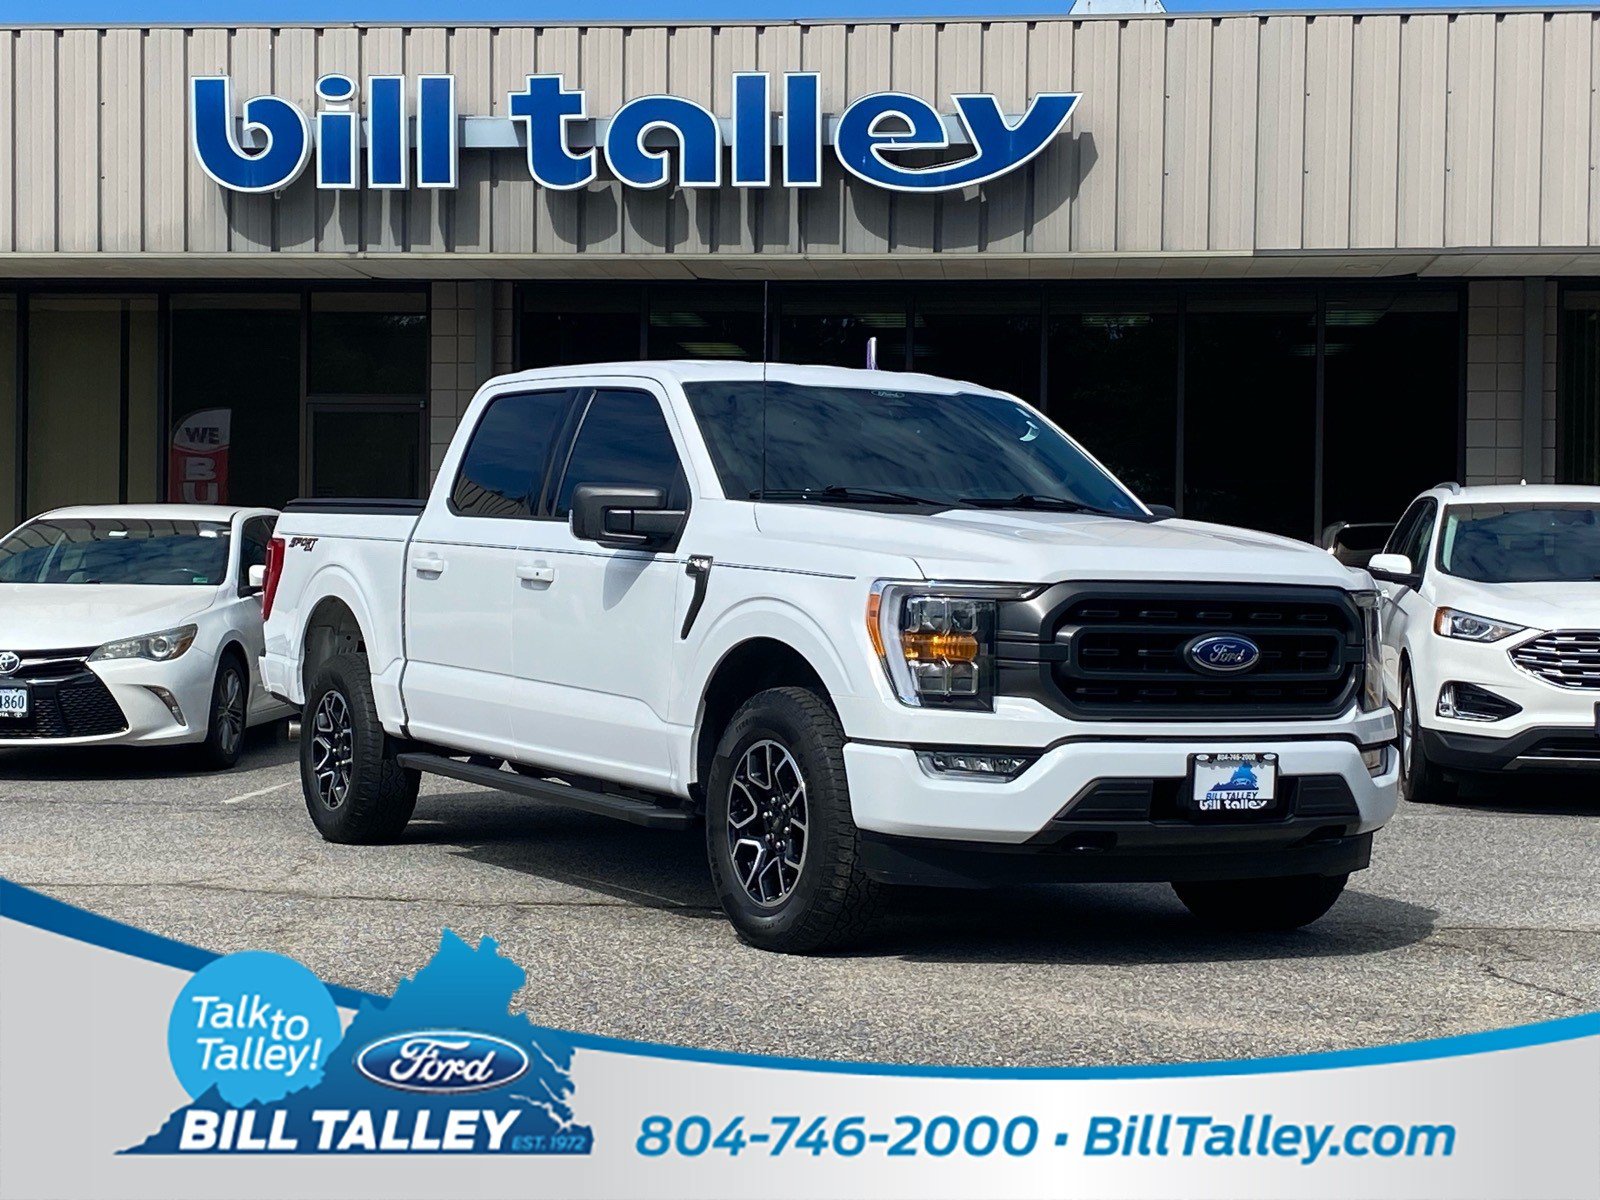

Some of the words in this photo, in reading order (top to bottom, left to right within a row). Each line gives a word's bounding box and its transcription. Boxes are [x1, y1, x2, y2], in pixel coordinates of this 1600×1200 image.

[190, 73, 457, 192] bill
[507, 71, 1084, 192] talley
[184, 427, 219, 445] WE
[1210, 643, 1246, 662] Ford
[1226, 791, 1258, 800] TALLEY
[1223, 800, 1267, 810] talley
